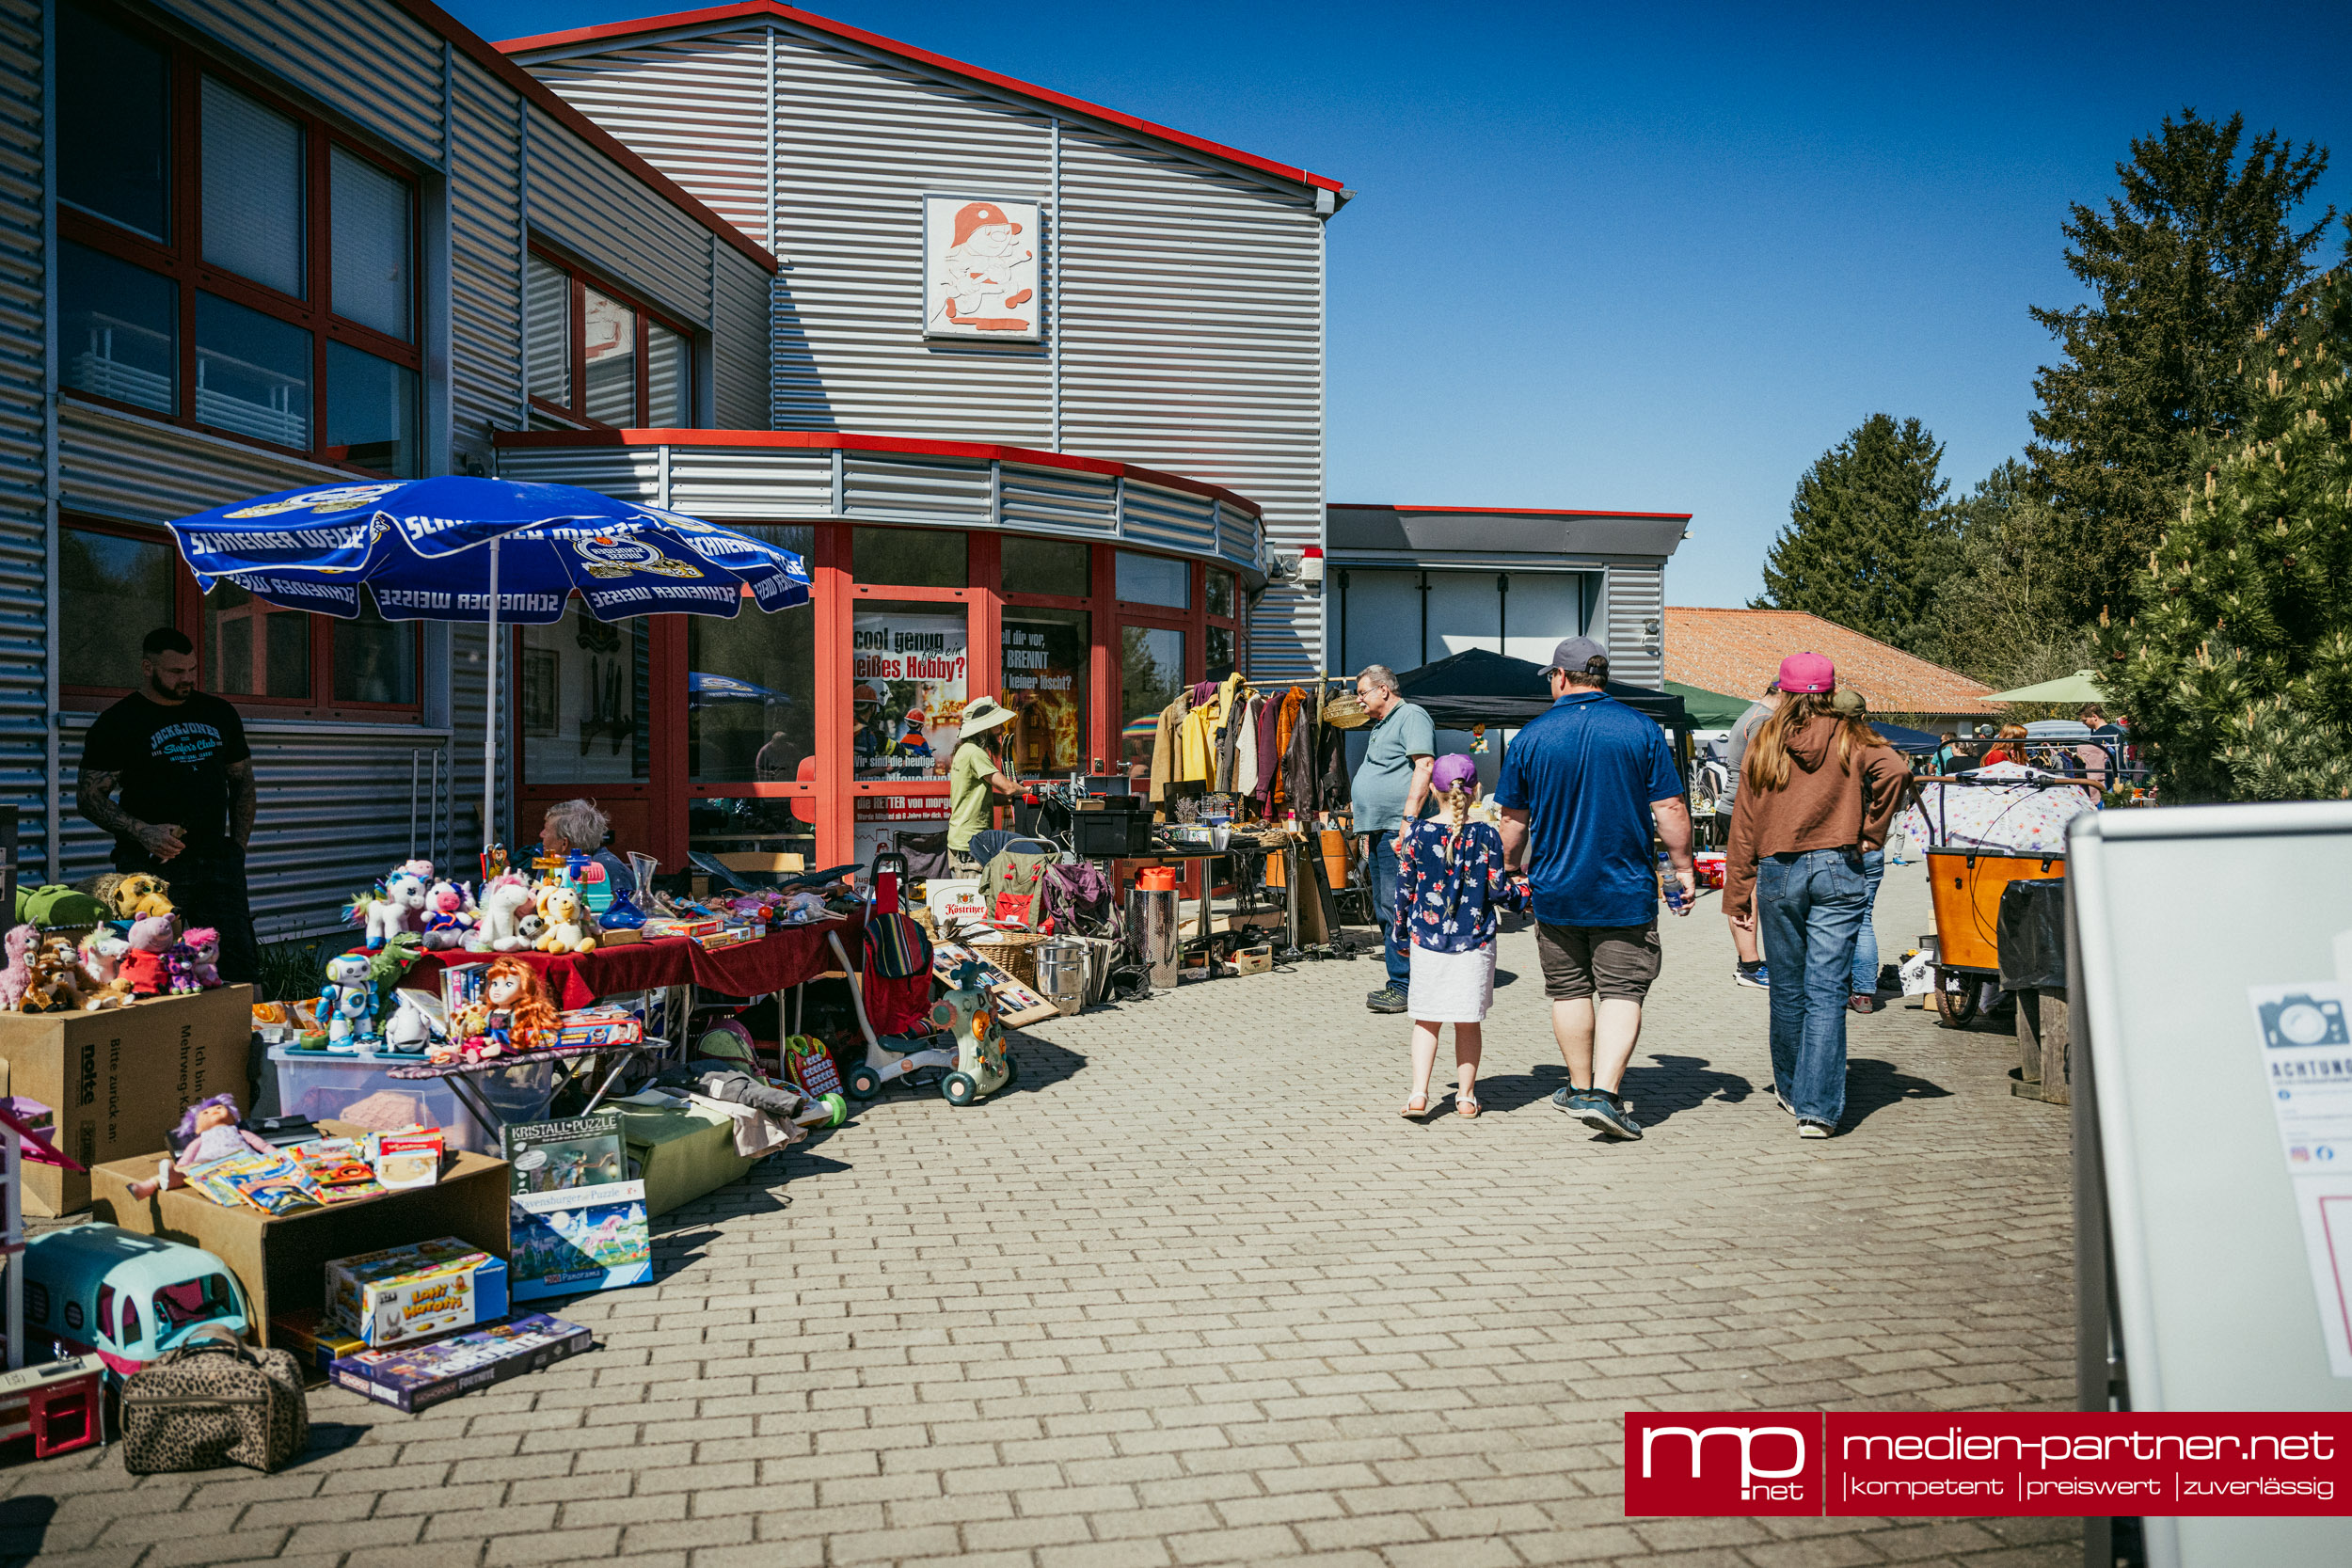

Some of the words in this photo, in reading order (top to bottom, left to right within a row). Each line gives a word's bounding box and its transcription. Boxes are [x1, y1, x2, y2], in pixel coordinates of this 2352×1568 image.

[189, 531, 300, 556] SCHNEIDER
[853, 627, 888, 651] cool
[895, 631, 944, 654] genug
[946, 642, 962, 657] ein
[1001, 629, 1011, 645] ell
[1013, 629, 1026, 645] dir
[1028, 633, 1046, 649] vor,
[906, 656, 965, 683] Hobby?
[1007, 649, 1049, 670] BRENNT
[1009, 673, 1039, 689] keiner
[1041, 674, 1072, 690] löscht?
[151, 722, 221, 750] JACK&JONES
[197, 738, 215, 751] Club
[870, 755, 888, 768] sind
[890, 755, 903, 768] die
[905, 755, 935, 769] heutige
[857, 796, 870, 809] die
[874, 796, 906, 809] RETTER
[908, 798, 923, 809] von
[907, 812, 922, 820] Jahre
[945, 903, 985, 915] Köstritzer
[110, 1037, 120, 1070] Bitte
[195, 1046, 206, 1067] Ich
[84, 1044, 98, 1106] nolte
[195, 1069, 206, 1092] bin
[109, 1076, 119, 1119] zurück
[108, 1123, 118, 1144] an:
[517, 1194, 581, 1210] Ravensburger
[591, 1188, 620, 1201] Puzzle
[562, 1269, 601, 1282] Panorama
[411, 1283, 450, 1305] Lotti
